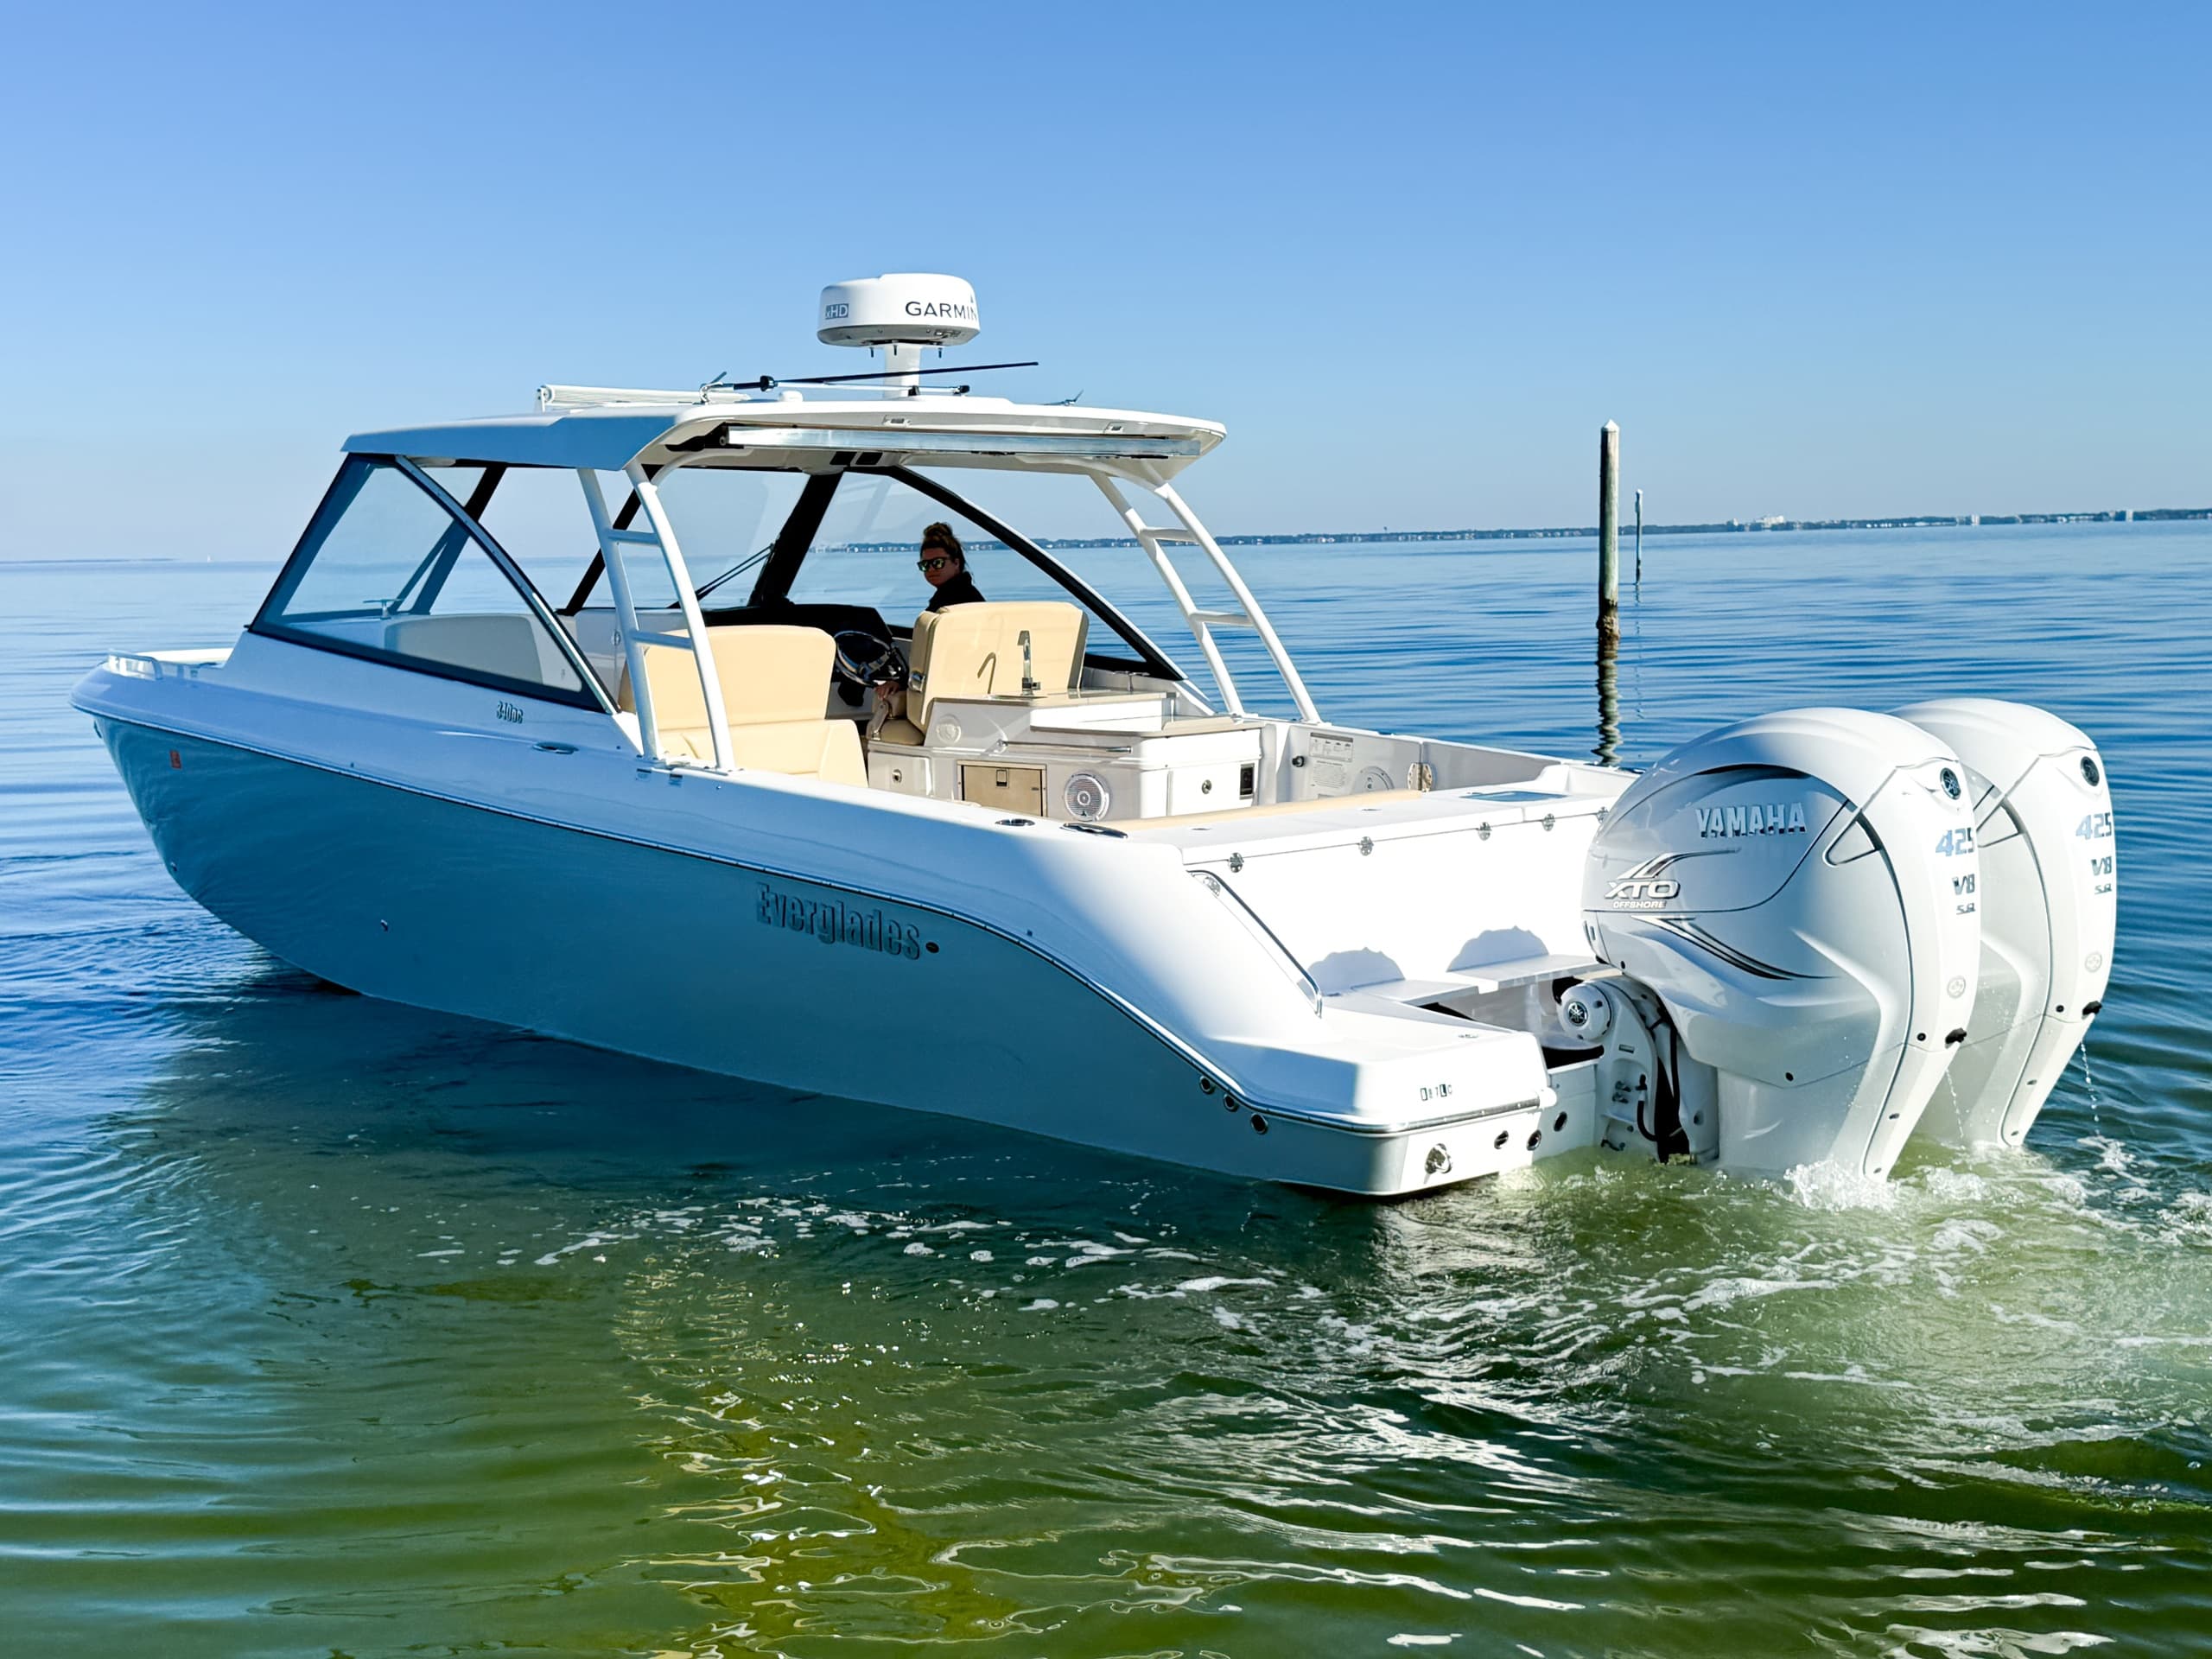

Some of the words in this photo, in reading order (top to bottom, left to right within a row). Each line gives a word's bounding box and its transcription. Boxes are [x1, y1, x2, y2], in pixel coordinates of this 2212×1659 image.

[906, 301, 978, 321] GARMIN
[1696, 802, 1806, 837] YAMAHA
[2075, 812, 2112, 840] 425
[1935, 827, 1975, 856] 425
[2091, 856, 2113, 876] V8
[1605, 880, 1681, 899] XTO
[1951, 874, 1975, 895] V8
[1612, 900, 1668, 910] OFFSHORE
[756, 881, 921, 960] Everglades
